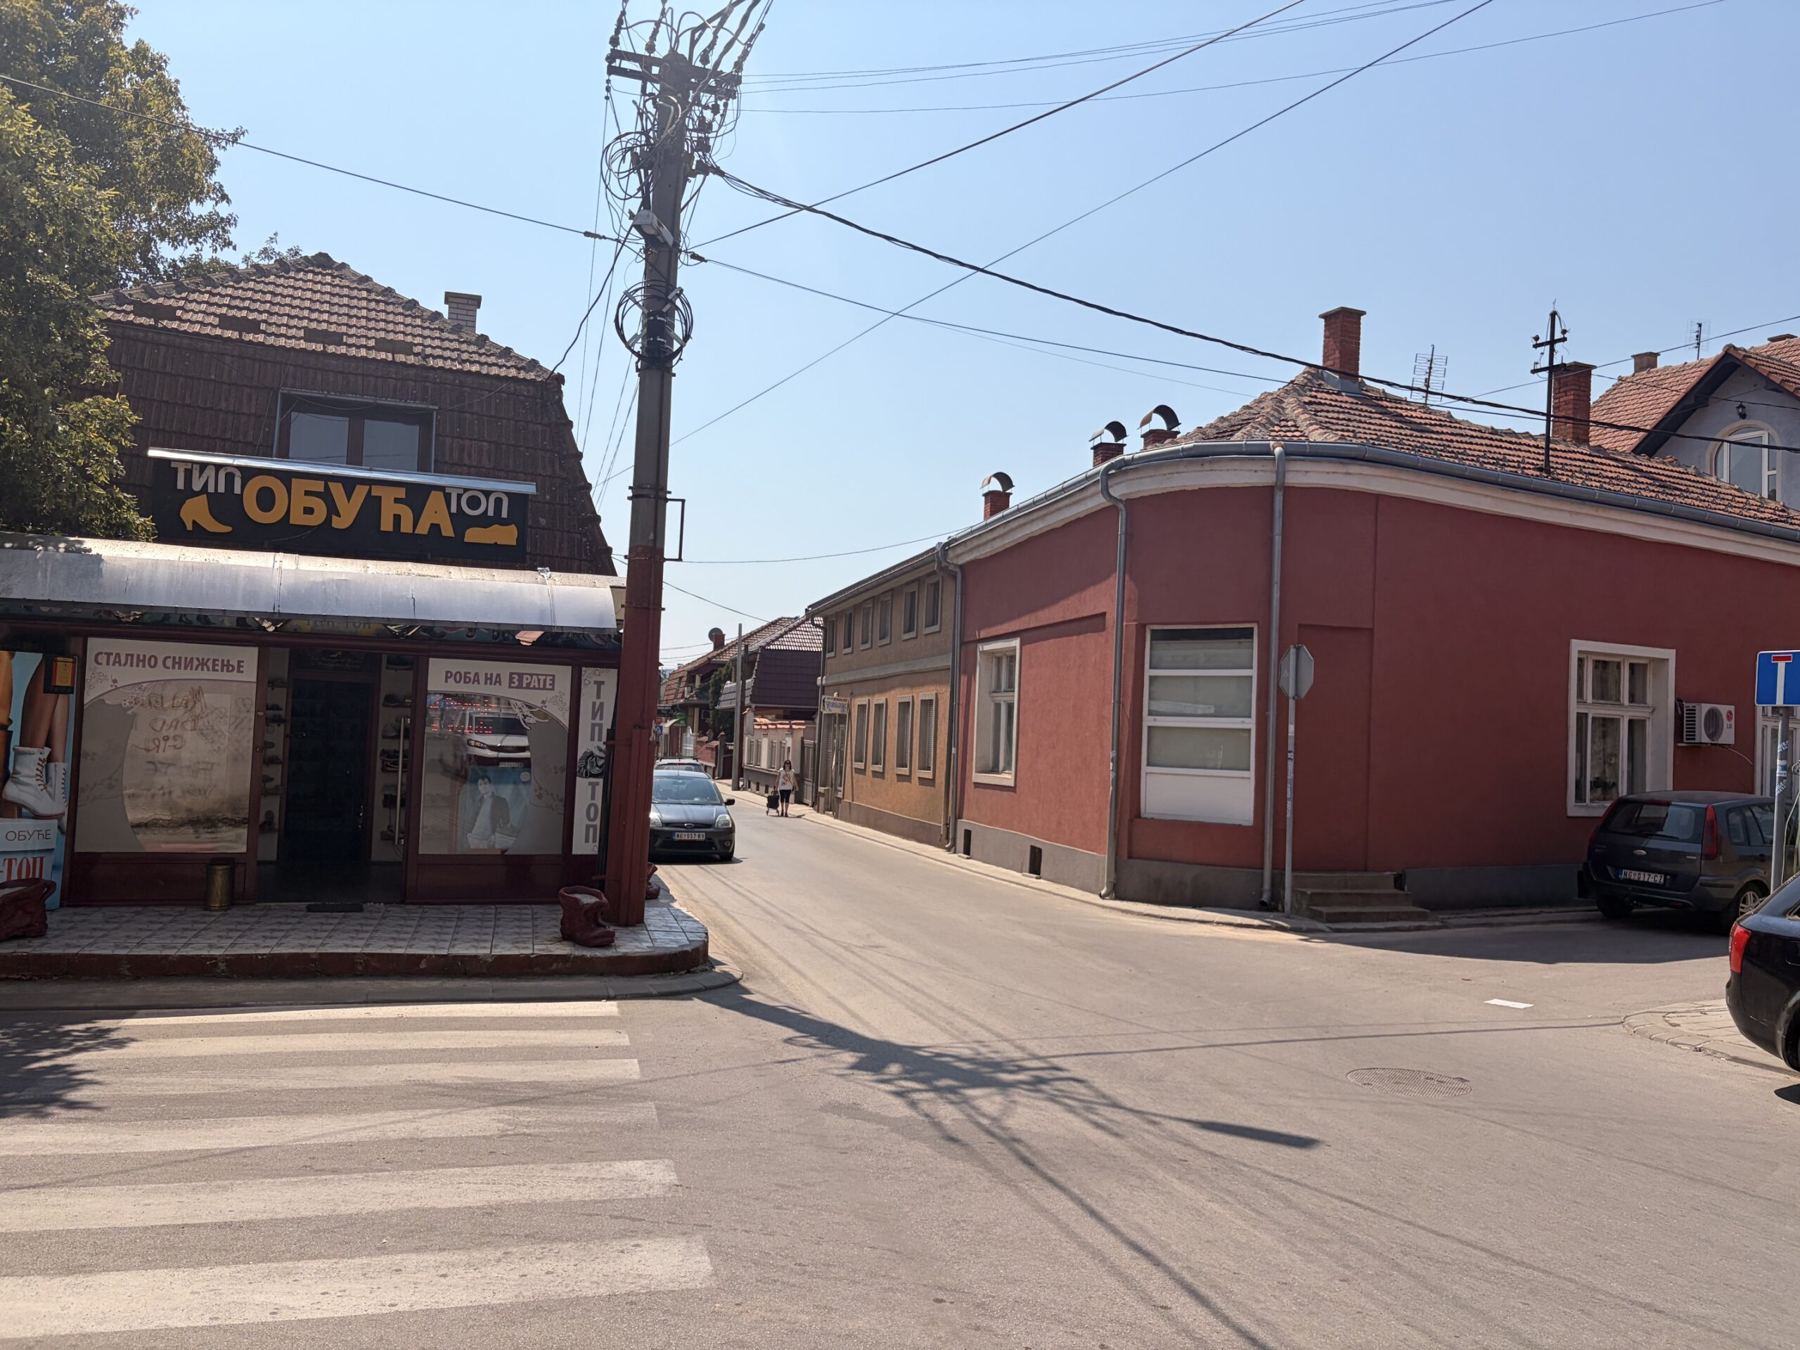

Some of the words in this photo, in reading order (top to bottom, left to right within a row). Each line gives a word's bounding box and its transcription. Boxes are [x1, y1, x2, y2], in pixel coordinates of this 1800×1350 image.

[243, 475, 456, 537] ОБУЋА
[93, 651, 159, 669] СТАЛНО
[161, 654, 245, 674] СНИЖЕЊЕ
[444, 670, 481, 685] РОБА
[484, 672, 502, 687] НА
[511, 676, 519, 688] 3
[522, 676, 554, 690] РАТЕ
[589, 679, 606, 742] ТИП
[584, 781, 600, 844] ТОП
[5, 829, 52, 842] ОБУЋЕ
